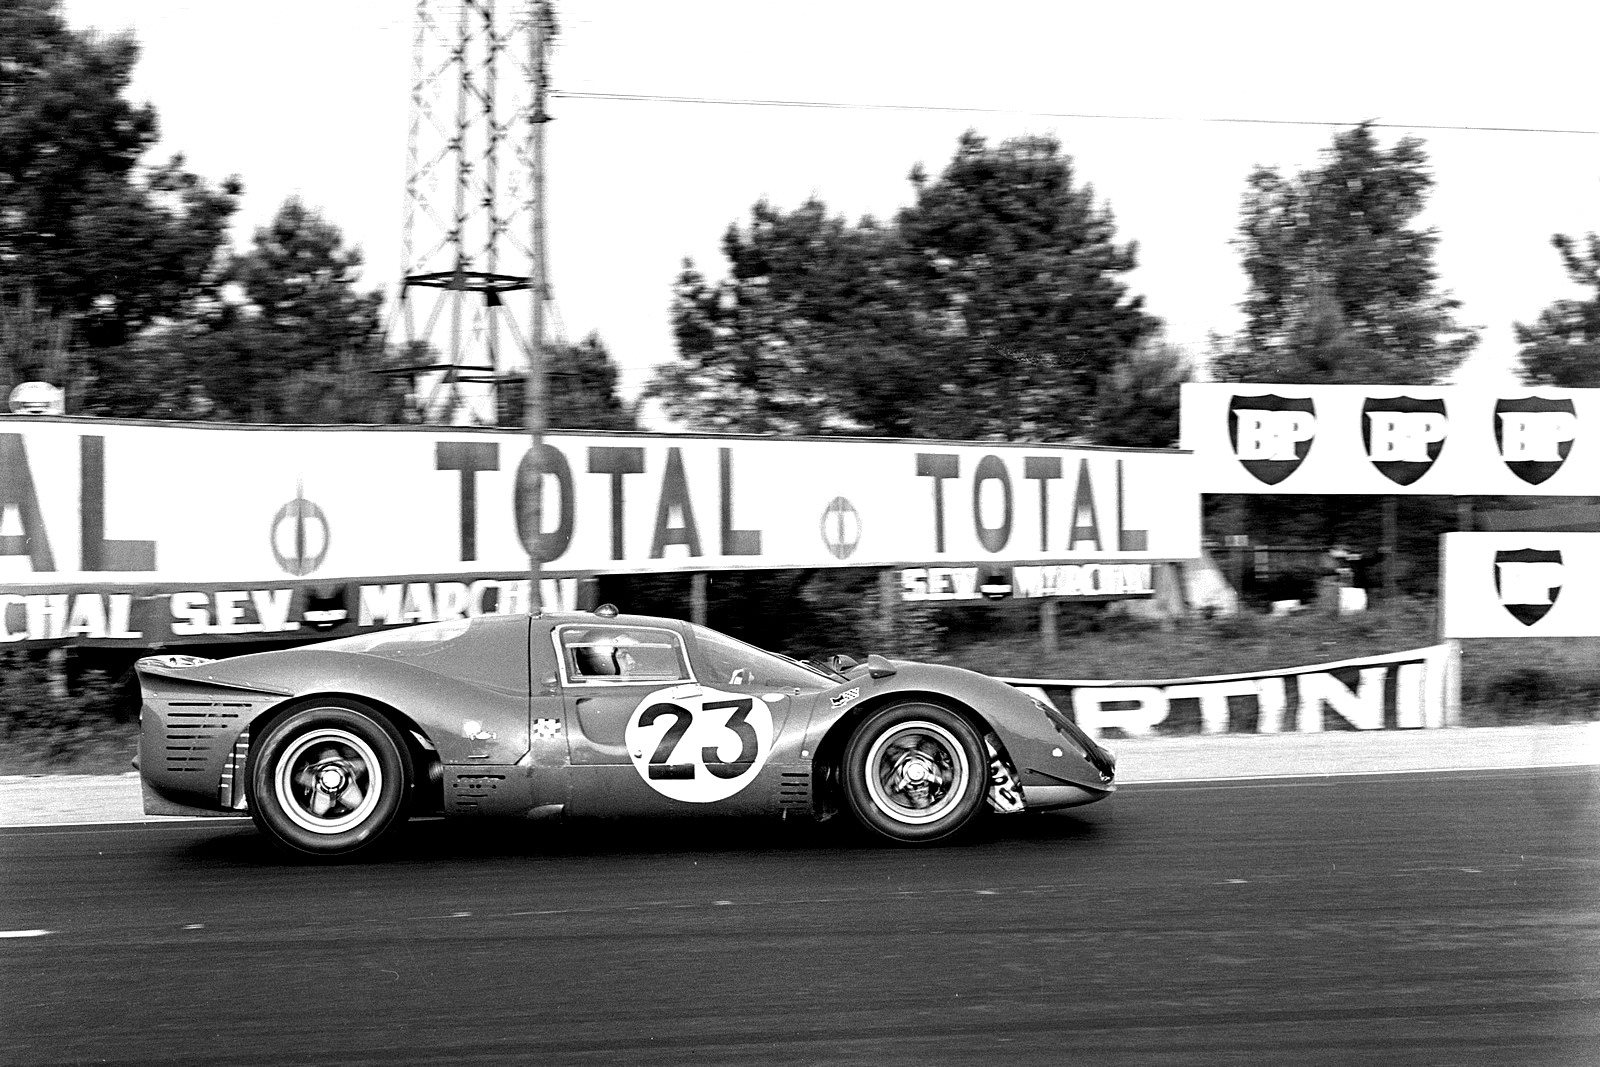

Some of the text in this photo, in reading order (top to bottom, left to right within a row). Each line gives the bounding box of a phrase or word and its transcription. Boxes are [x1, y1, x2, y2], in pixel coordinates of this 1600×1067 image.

[1233, 409, 1316, 461] BP
[1364, 411, 1447, 462] BP
[436, 441, 763, 563] TOTAL
[916, 453, 1148, 553] TOTAL
[638, 698, 759, 780] 23
